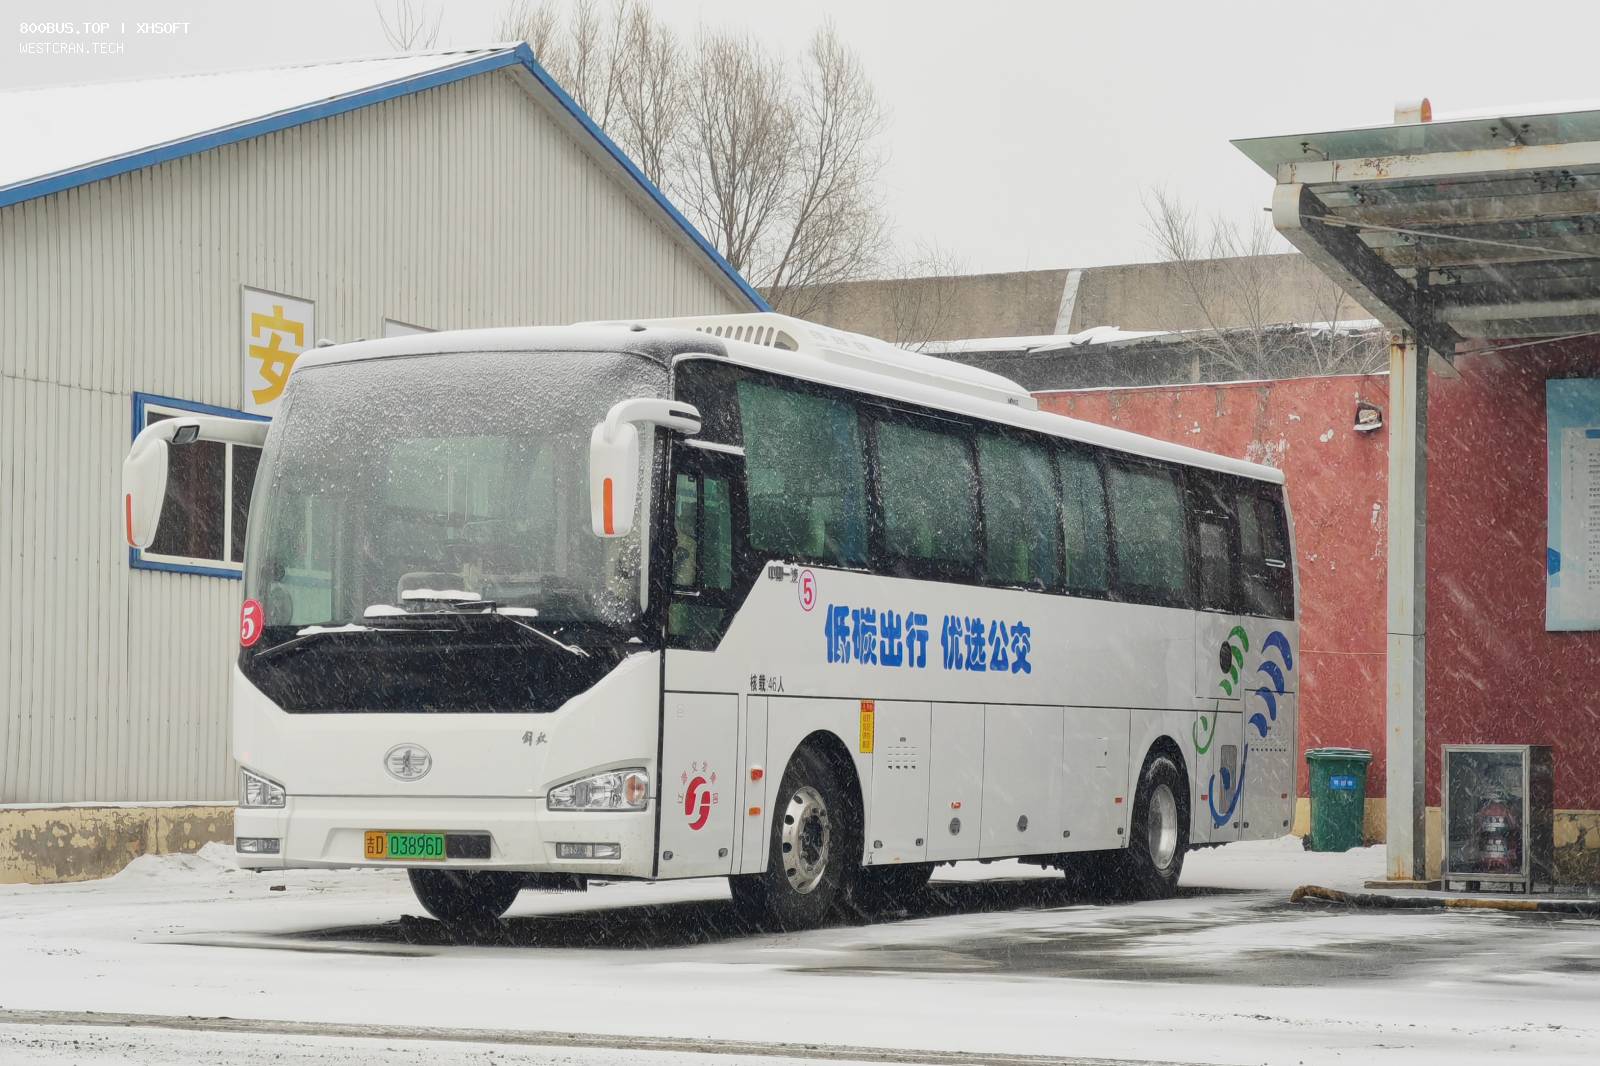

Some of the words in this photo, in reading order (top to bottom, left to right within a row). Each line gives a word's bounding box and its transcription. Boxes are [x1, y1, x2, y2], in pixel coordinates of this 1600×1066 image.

[249, 304, 304, 405] 安
[803, 577, 813, 605] 5
[241, 606, 255, 640] 5
[825, 603, 929, 669] 低碳出行
[941, 614, 1032, 675] 优选公交
